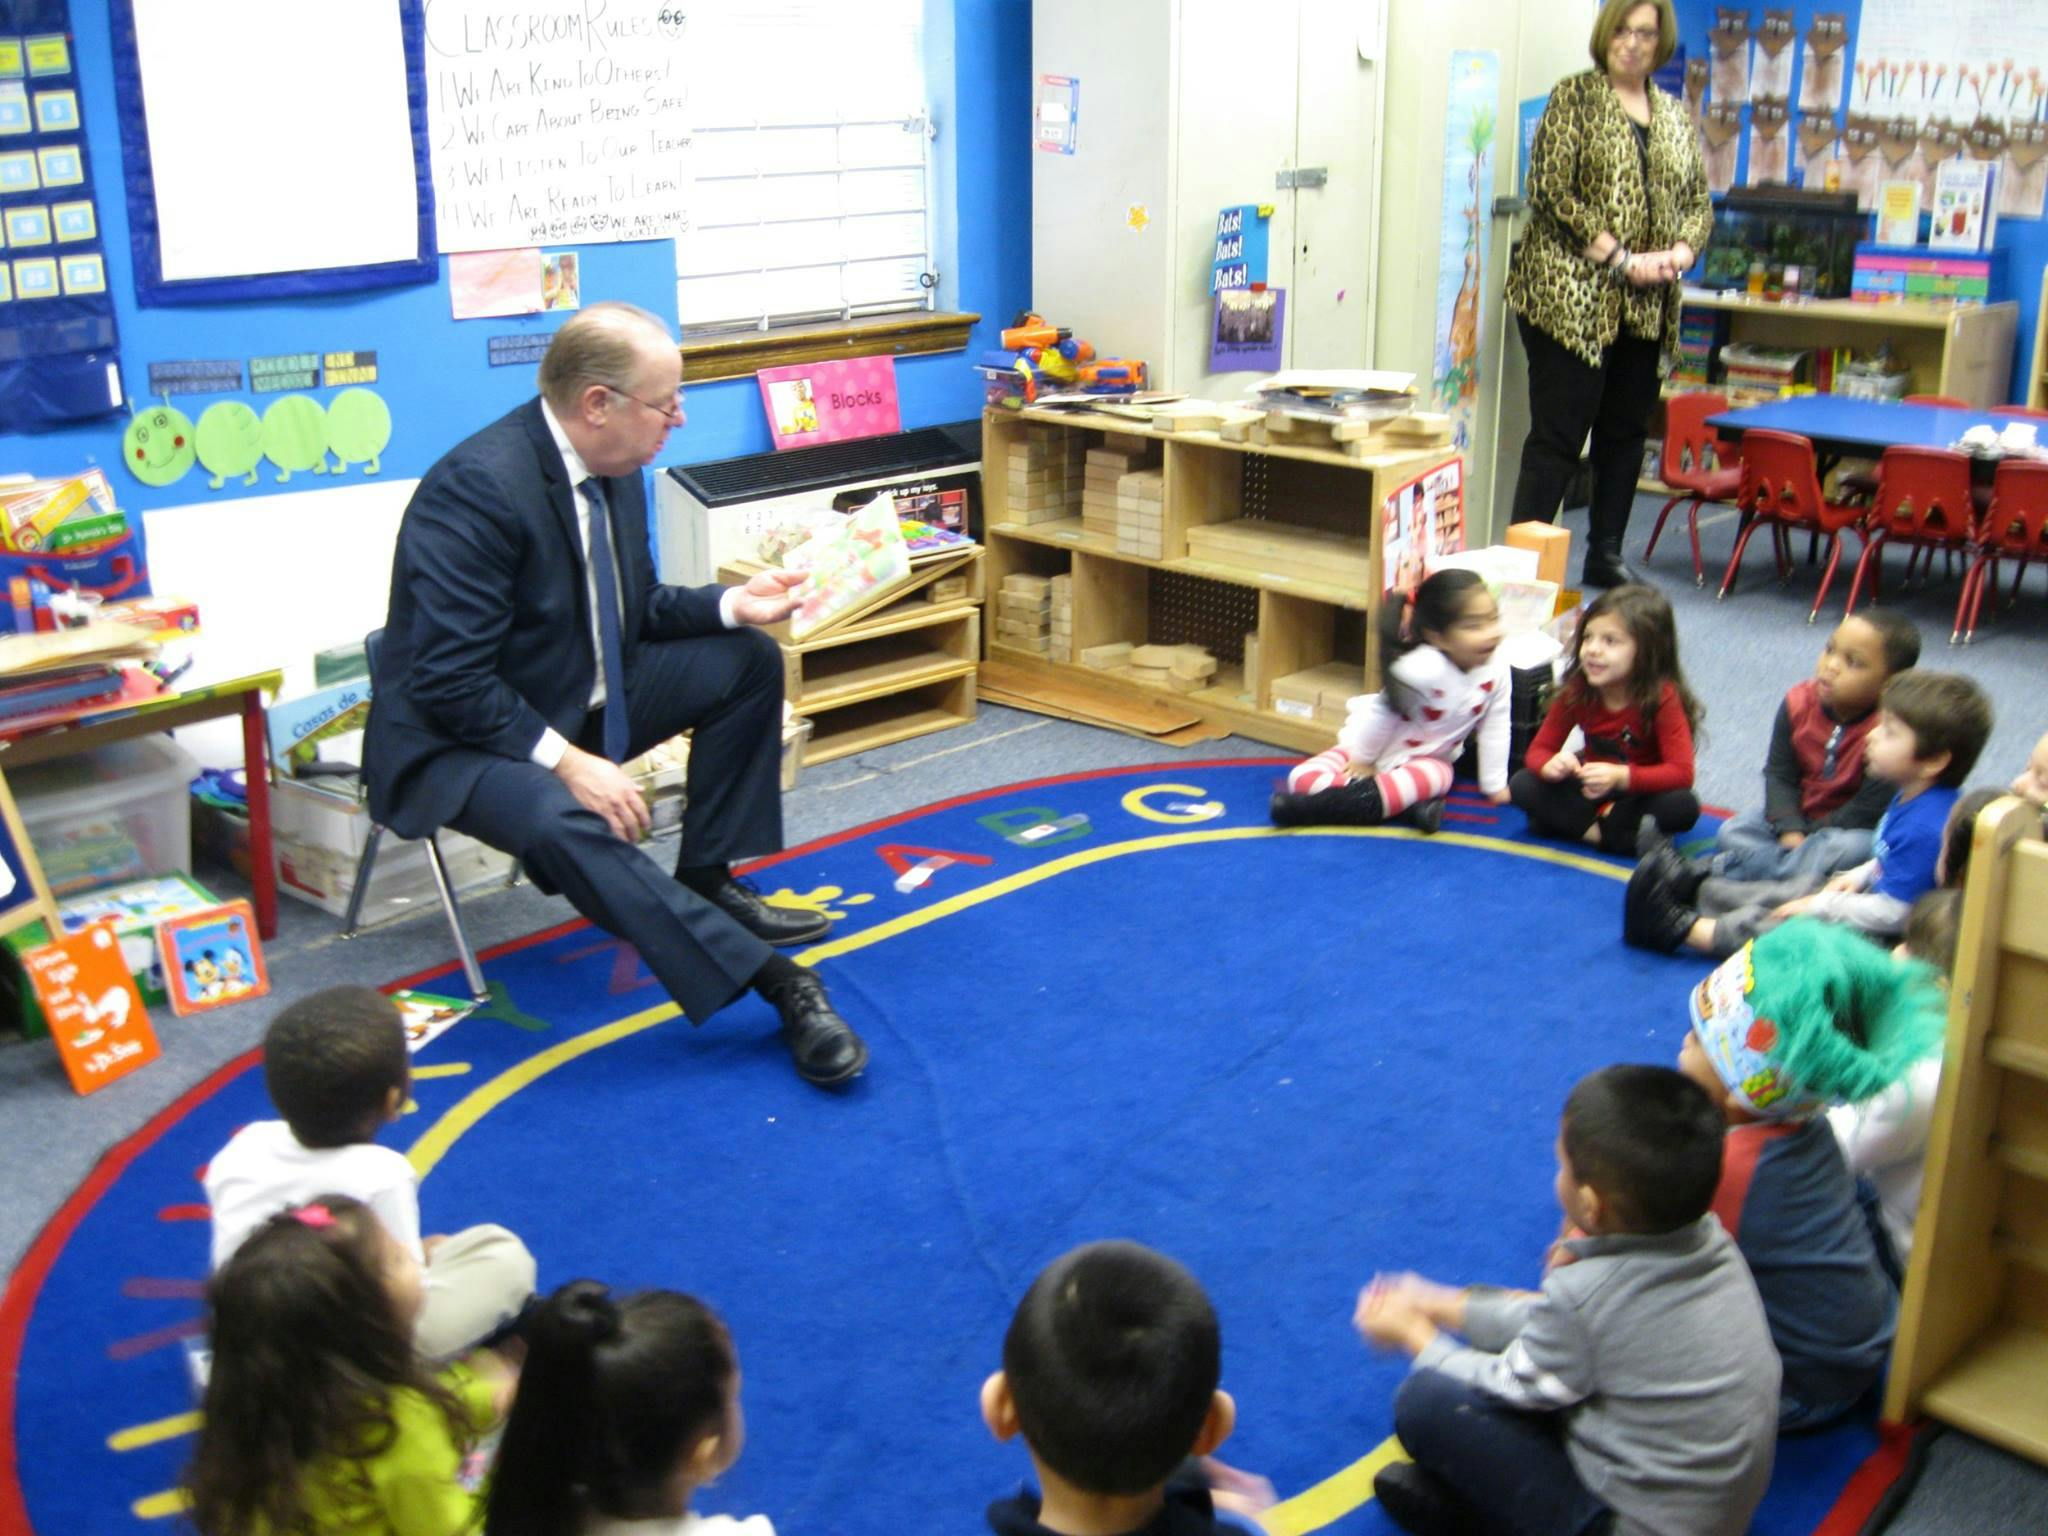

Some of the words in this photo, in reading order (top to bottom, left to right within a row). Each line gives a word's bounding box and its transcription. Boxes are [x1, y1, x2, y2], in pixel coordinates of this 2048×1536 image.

[424, 0, 583, 57] CLASSROOM
[584, 0, 653, 52] RULES
[452, 71, 480, 109] WE
[489, 67, 521, 102] ARE
[528, 60, 573, 96] KIND
[461, 113, 486, 145] WE
[536, 107, 582, 134] ABOUT
[589, 97, 641, 124] BEING
[508, 192, 537, 224] ARE
[546, 185, 598, 215] READY
[1217, 208, 1243, 236] Bats!
[1215, 235, 1244, 262] Bats!
[1214, 264, 1248, 290] Bats!
[831, 390, 883, 410] Blocks
[292, 705, 336, 740] Casas
[338, 691, 359, 710] de
